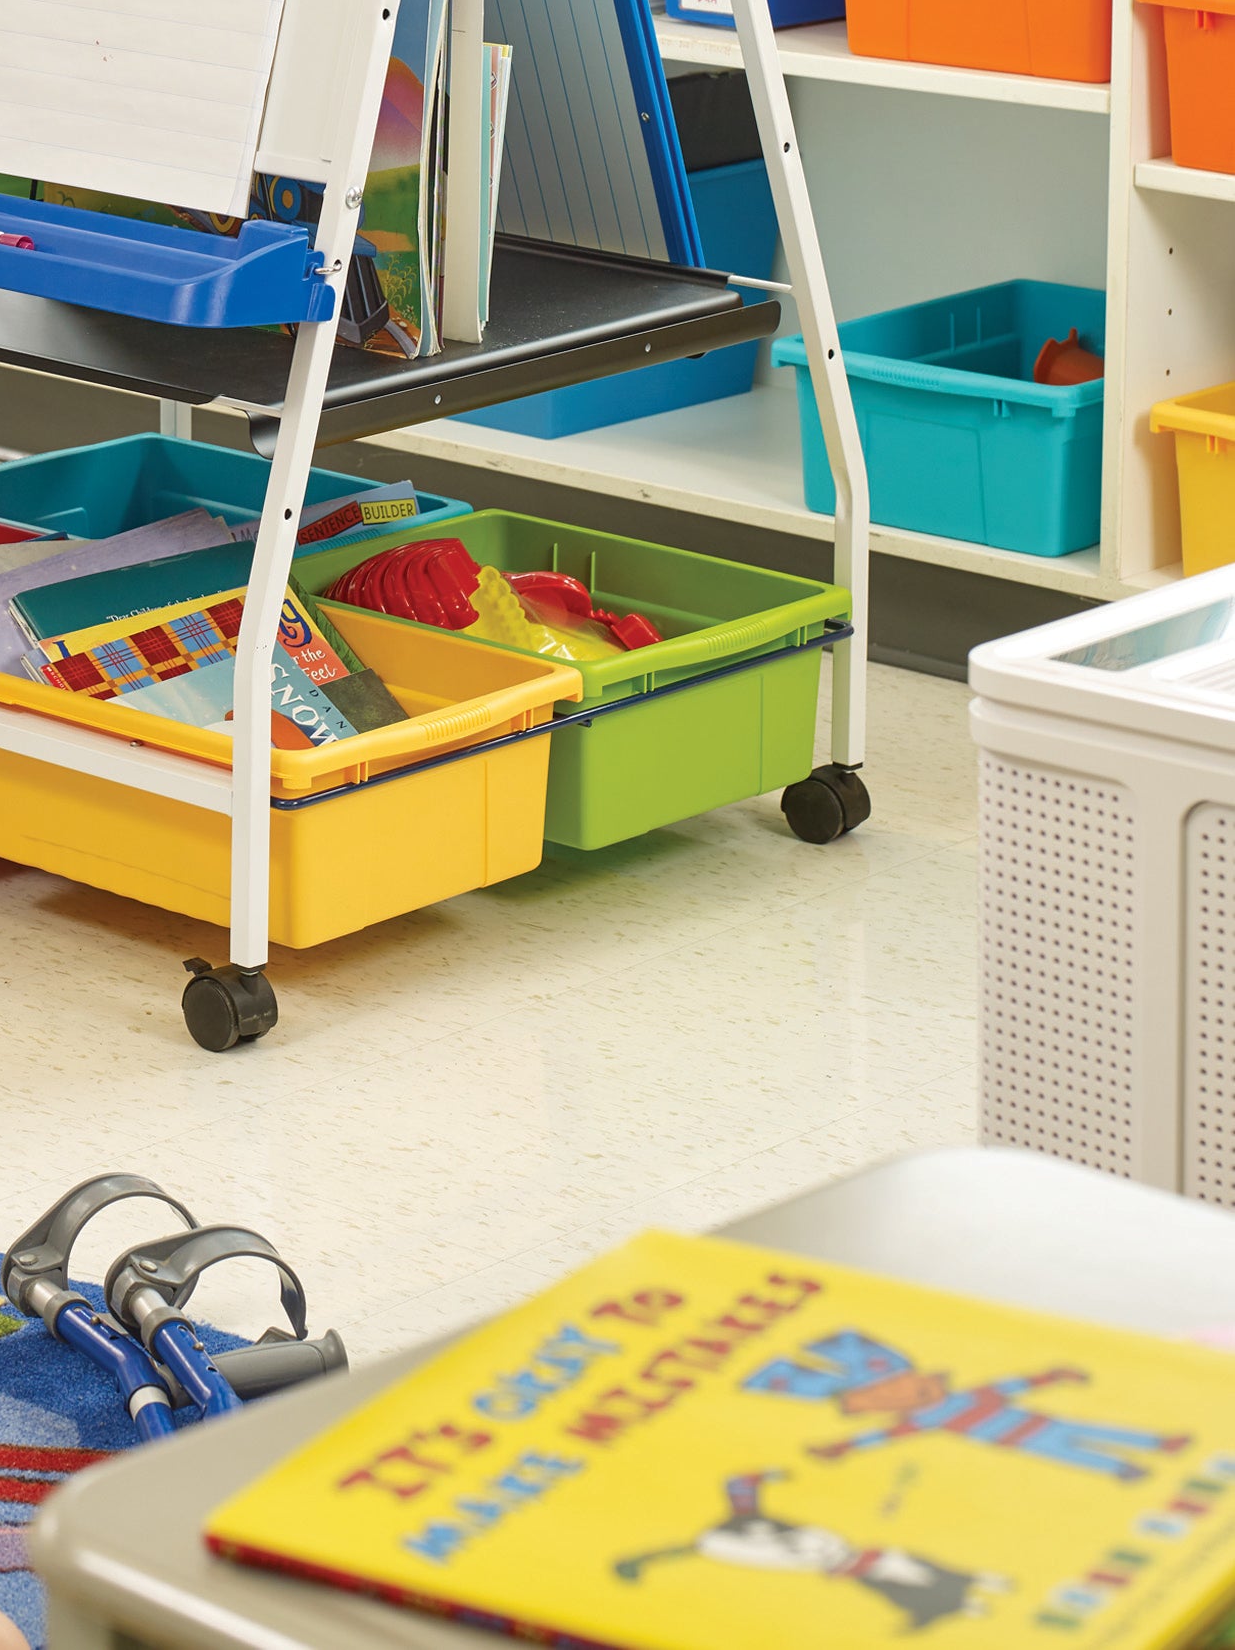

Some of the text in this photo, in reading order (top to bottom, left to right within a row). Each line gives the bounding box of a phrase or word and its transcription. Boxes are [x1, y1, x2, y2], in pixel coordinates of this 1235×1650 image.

[299, 502, 415, 544] SENTENCE BUILDER
[301, 647, 326, 664] the
[471, 1322, 623, 1420] OKAY
[402, 1272, 823, 1565] MAKE MISTAKES
